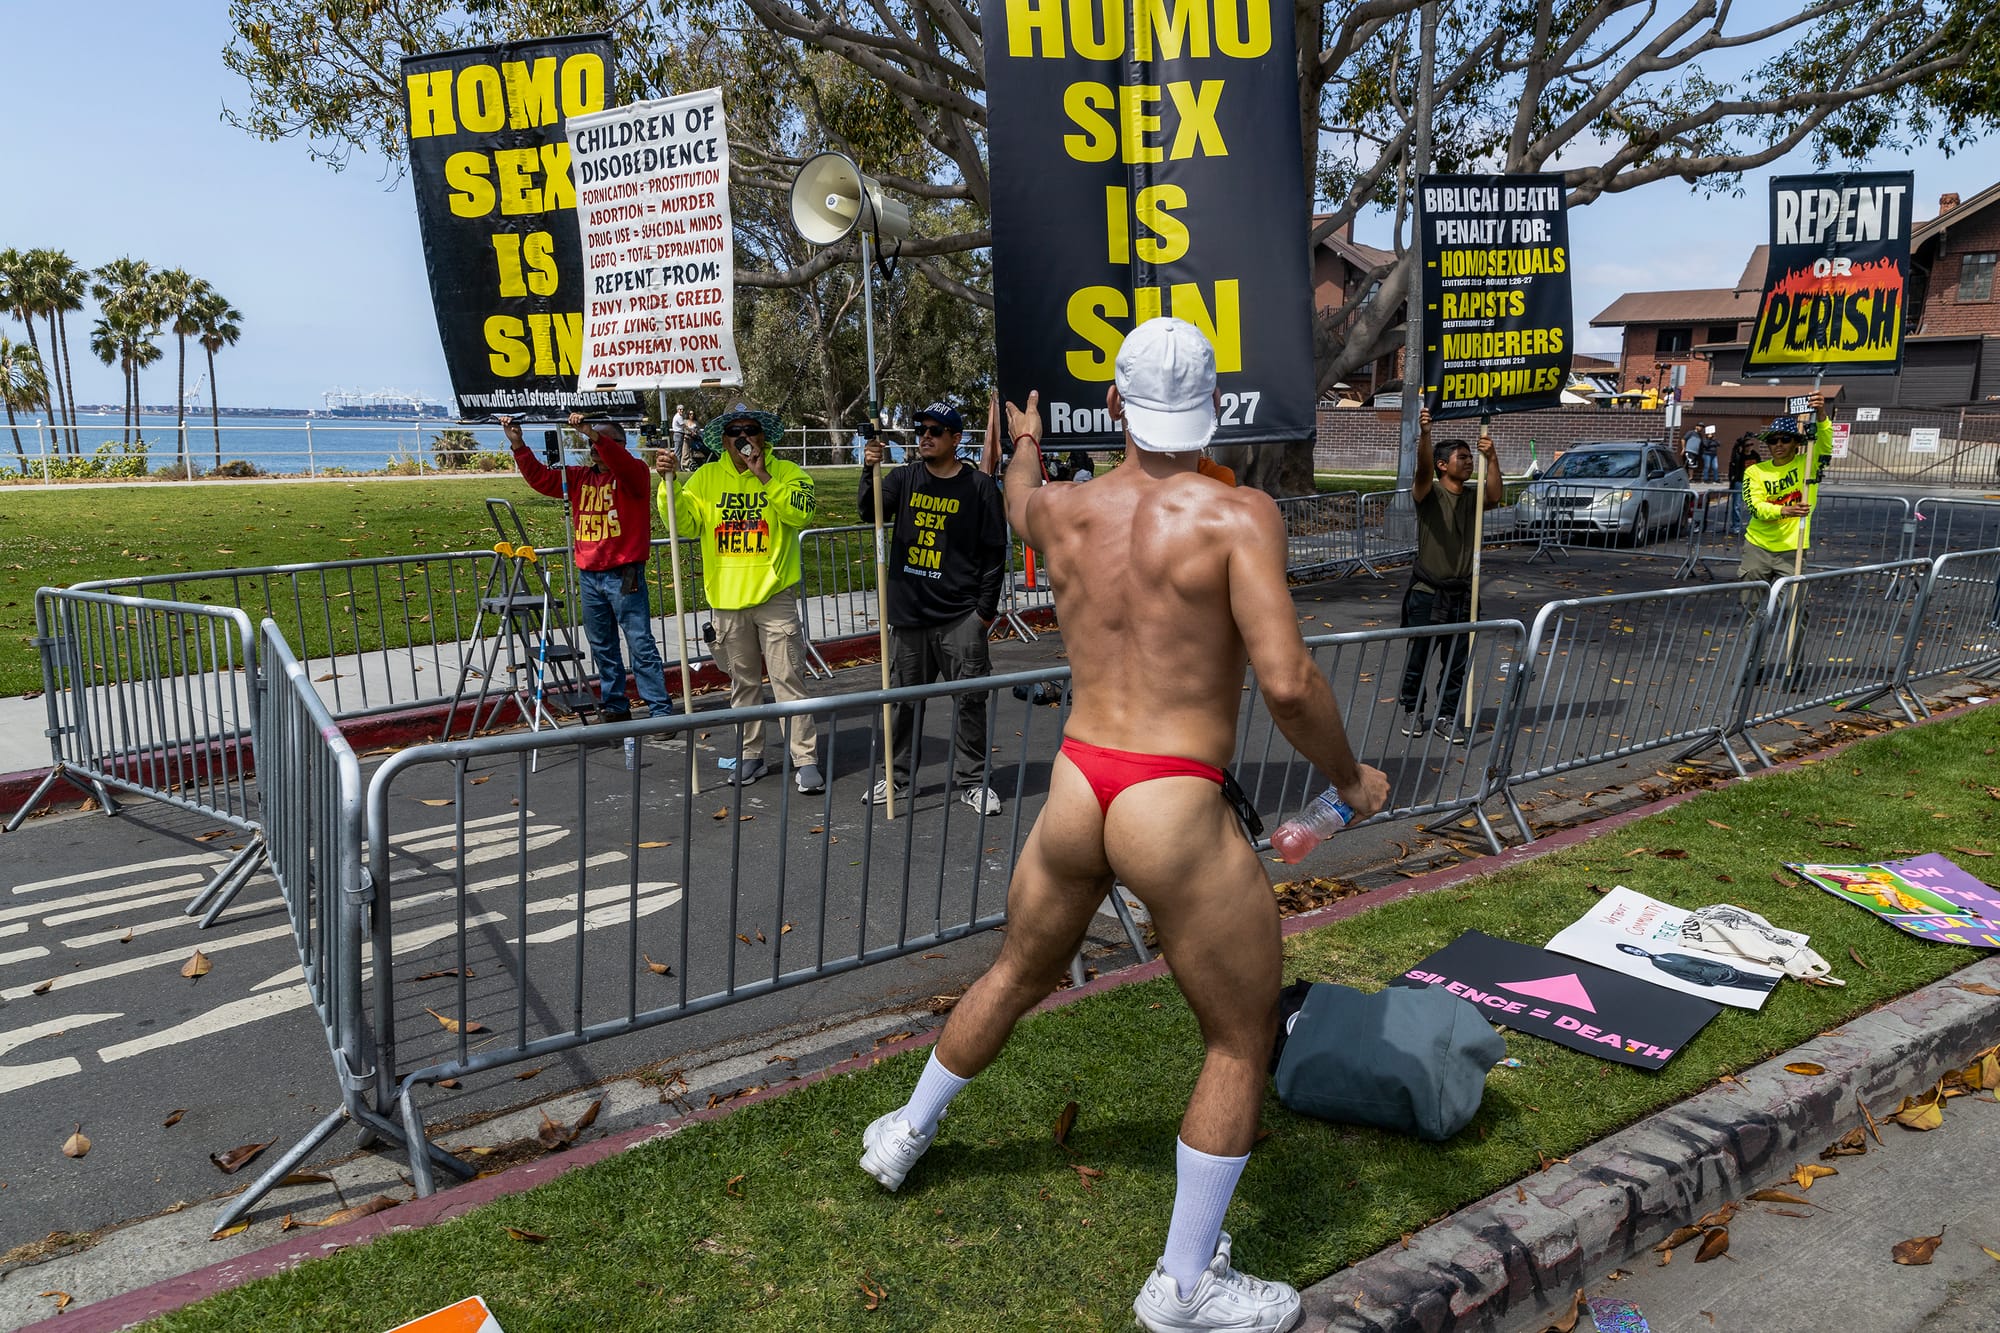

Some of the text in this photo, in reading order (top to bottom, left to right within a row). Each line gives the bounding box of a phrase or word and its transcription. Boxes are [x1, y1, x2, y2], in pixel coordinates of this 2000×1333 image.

[1005, 0, 1273, 62] HOMO
[406, 52, 605, 139] HOMO
[576, 105, 715, 154] CHILDREN OF
[1063, 79, 1230, 165] SEX
[580, 138, 719, 185] DISOBEDIENCE
[445, 141, 577, 219] SEX
[582, 182, 638, 206] FORNICATION
[649, 169, 720, 194] PROSTITUTION
[589, 203, 644, 226] ABORTION
[661, 192, 715, 215] MURDER
[1424, 187, 1560, 213] BIBLICAL DEATH
[1776, 185, 1906, 245] REPENT
[588, 232, 613, 249] DRUG
[615, 227, 631, 244] USE
[642, 219, 686, 239] SUICIDAL
[689, 214, 723, 232] MINDS
[1105, 183, 1191, 265] IS
[1435, 218, 1551, 245] PENALTY FOR:
[492, 231, 558, 298] IS
[590, 251, 617, 270] LGBTQ
[627, 245, 652, 263] TOTAL
[657, 237, 724, 260] DEPRAVATION
[1441, 247, 1566, 278] HOMOSEXUALS
[1813, 257, 1853, 279] OR
[595, 261, 720, 295] REPENT FROM:
[1441, 279, 1471, 287] LEVITICUS
[592, 287, 724, 317] ENVY, PRIDE, GREED,
[1442, 290, 1525, 320] RAPISTS
[590, 310, 724, 338] LUST, LYING, STEALING,
[1757, 287, 1900, 355] PERISH
[484, 312, 584, 378] SIN
[593, 334, 722, 358] BLASPHEMY, PORN,
[1442, 327, 1564, 360] MURDERERS
[587, 356, 732, 379] MASTURBATION, ETC.
[1442, 367, 1561, 400] PEDOPHILES
[1790, 396, 1811, 406] HOL
[579, 479, 617, 512] TRUS
[716, 491, 769, 509] JESUS
[909, 492, 960, 514] HOMO
[722, 508, 762, 521] SAVES
[724, 519, 759, 531] FROM
[914, 511, 947, 530] SEX
[718, 531, 767, 553] HELL
[917, 530, 936, 547] IS
[907, 546, 942, 569] SIN
[1899, 867, 1944, 878] OH
[1404, 970, 1675, 1061] SILENCE = DEATH
[892, 1138, 911, 1155] FILA
